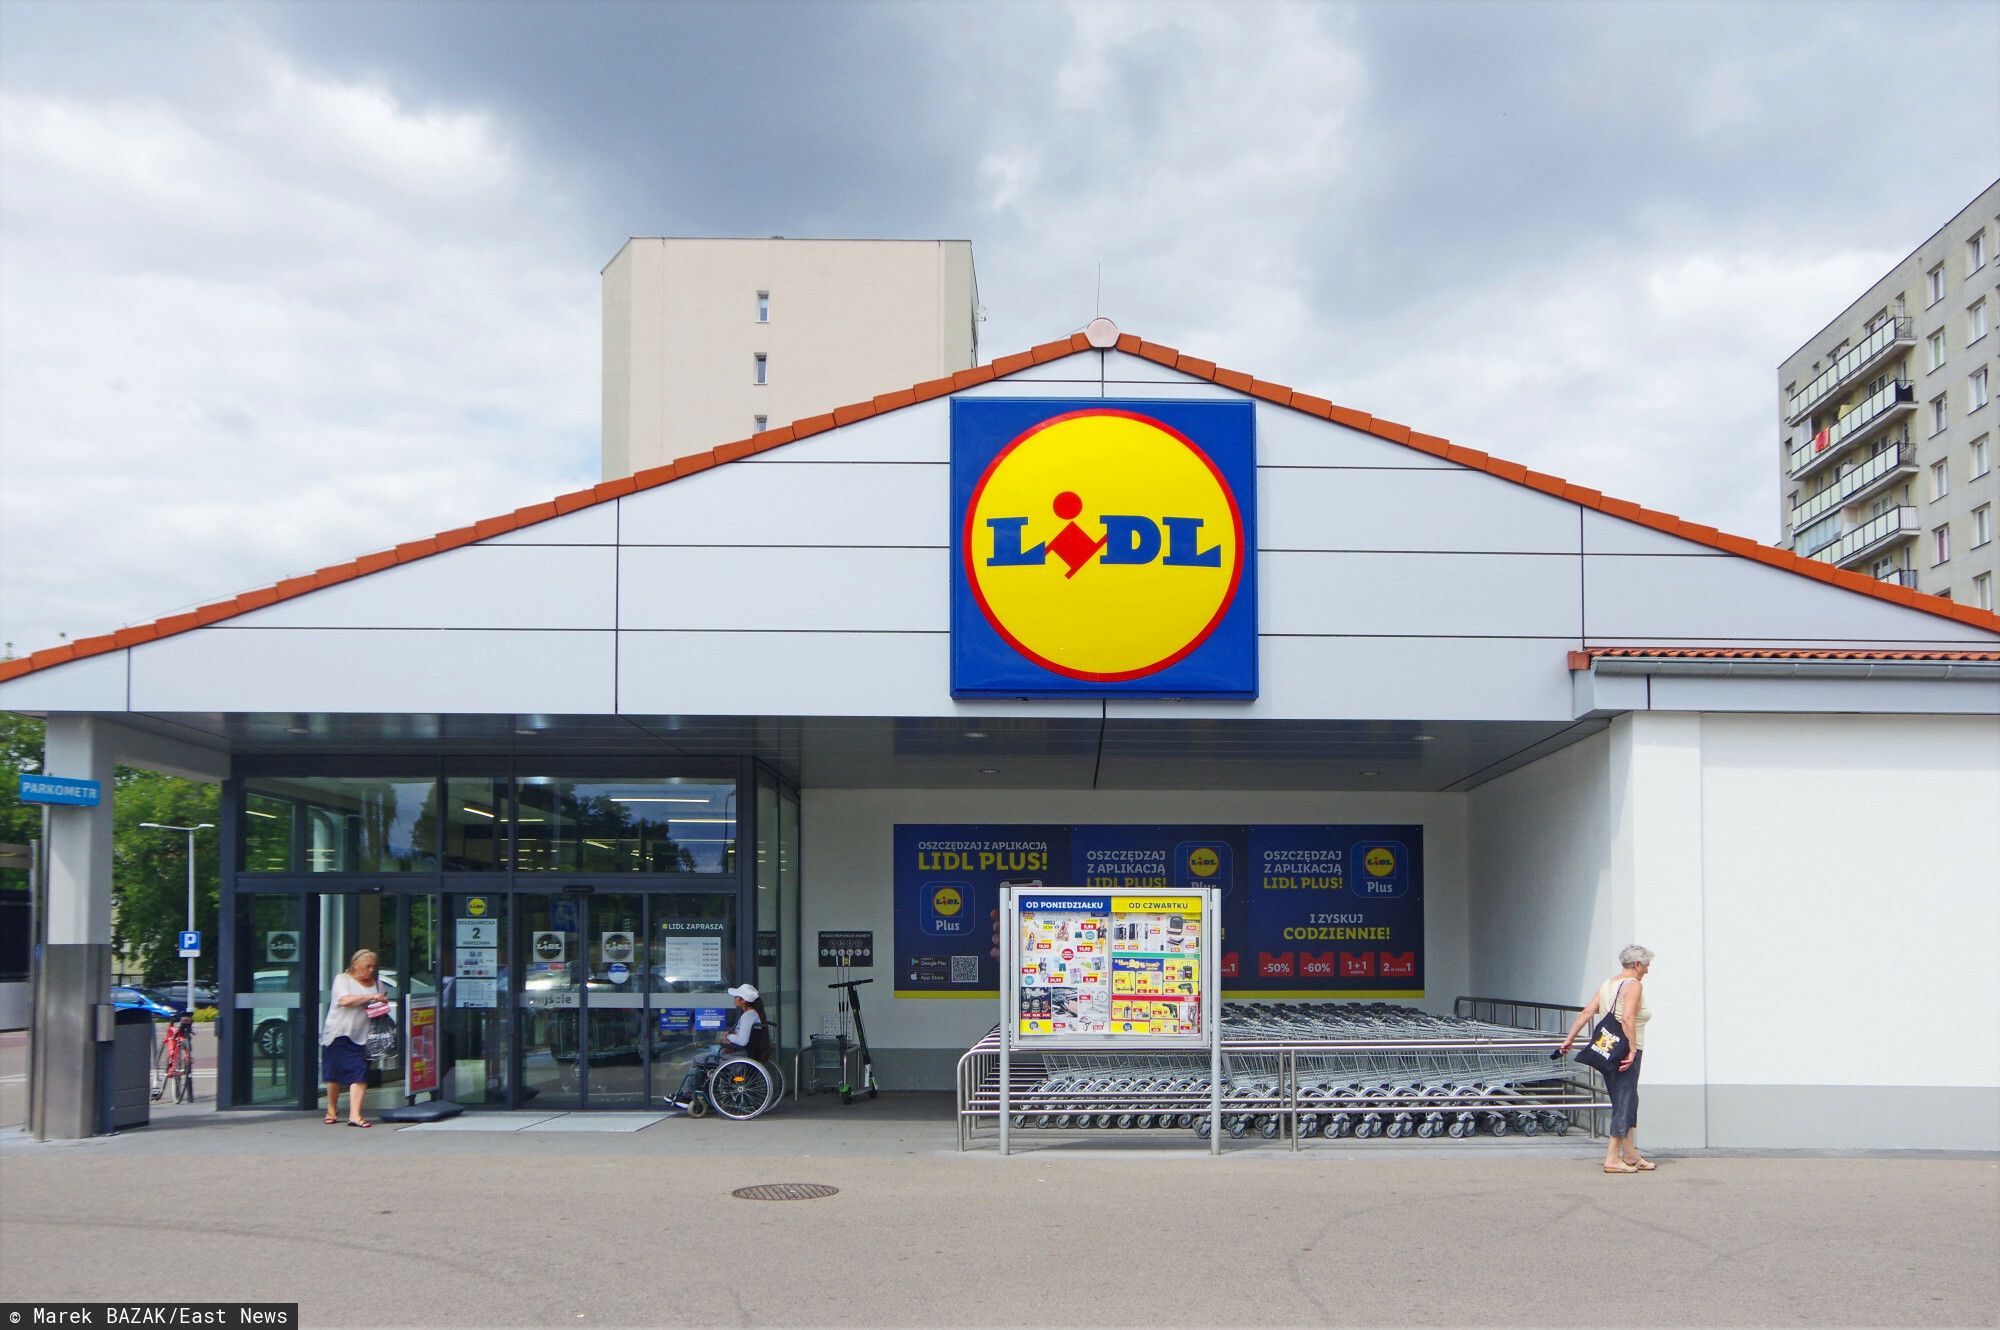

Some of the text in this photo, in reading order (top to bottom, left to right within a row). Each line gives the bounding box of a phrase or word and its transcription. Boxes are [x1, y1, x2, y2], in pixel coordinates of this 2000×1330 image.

[987, 491, 1221, 580] LIDL
[22, 782, 97, 798] PARKOMETR
[918, 841, 1047, 852] OSZCZĘDZAJ Z APLIKACJĄ
[918, 852, 1048, 871] LIDL PLUS!
[1087, 850, 1166, 862] OSZCZĘDZAJ
[1264, 850, 1342, 862] OSZCZĘDZAJ
[1087, 864, 1166, 876] Z APLIKACJĄ
[1264, 864, 1342, 876] Z APLIKACJĄ
[1263, 877, 1343, 889] LIDL PLUS!
[1367, 881, 1393, 893] Plus
[1025, 901, 1103, 909] OD PONIEDZIAŁKU
[935, 919, 960, 931] Plus
[1310, 914, 1364, 924] I ZYSKUJ
[472, 927, 480, 939] 2
[1283, 927, 1391, 940] CODZIENNIE!
[184, 933, 197, 948] P
[1263, 963, 1290, 973] -50%
[1303, 963, 1331, 973] -60%
[1383, 963, 1390, 972] 2
[1406, 963, 1411, 972] 1
